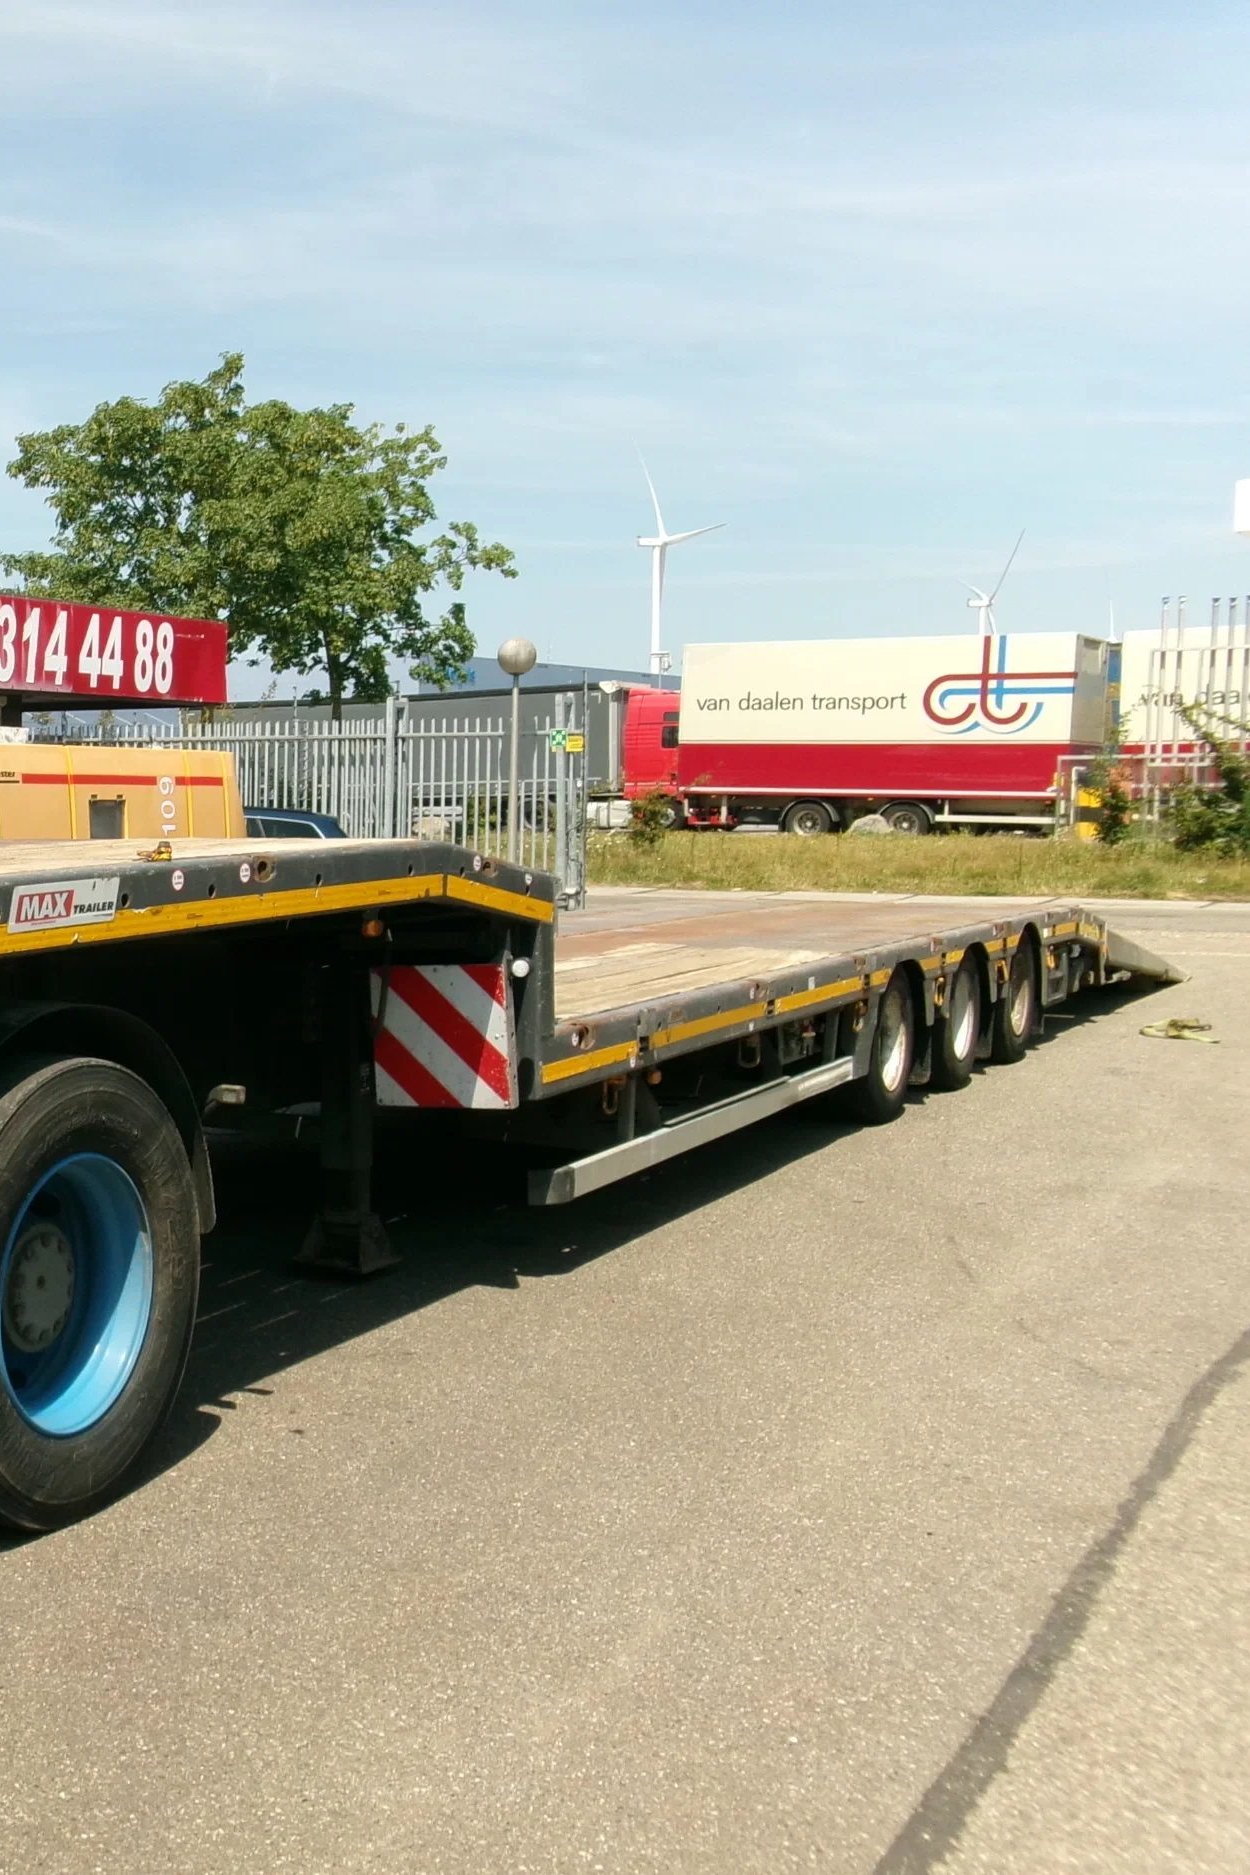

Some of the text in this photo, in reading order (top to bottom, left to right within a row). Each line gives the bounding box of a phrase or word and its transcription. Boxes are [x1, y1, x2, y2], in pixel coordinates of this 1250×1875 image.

[78, 613, 124, 689] 44
[134, 619, 175, 694] 88
[696, 691, 907, 715] van daalen transport
[158, 774, 176, 836] 109
[20, 891, 114, 921] MAX TRAILER
